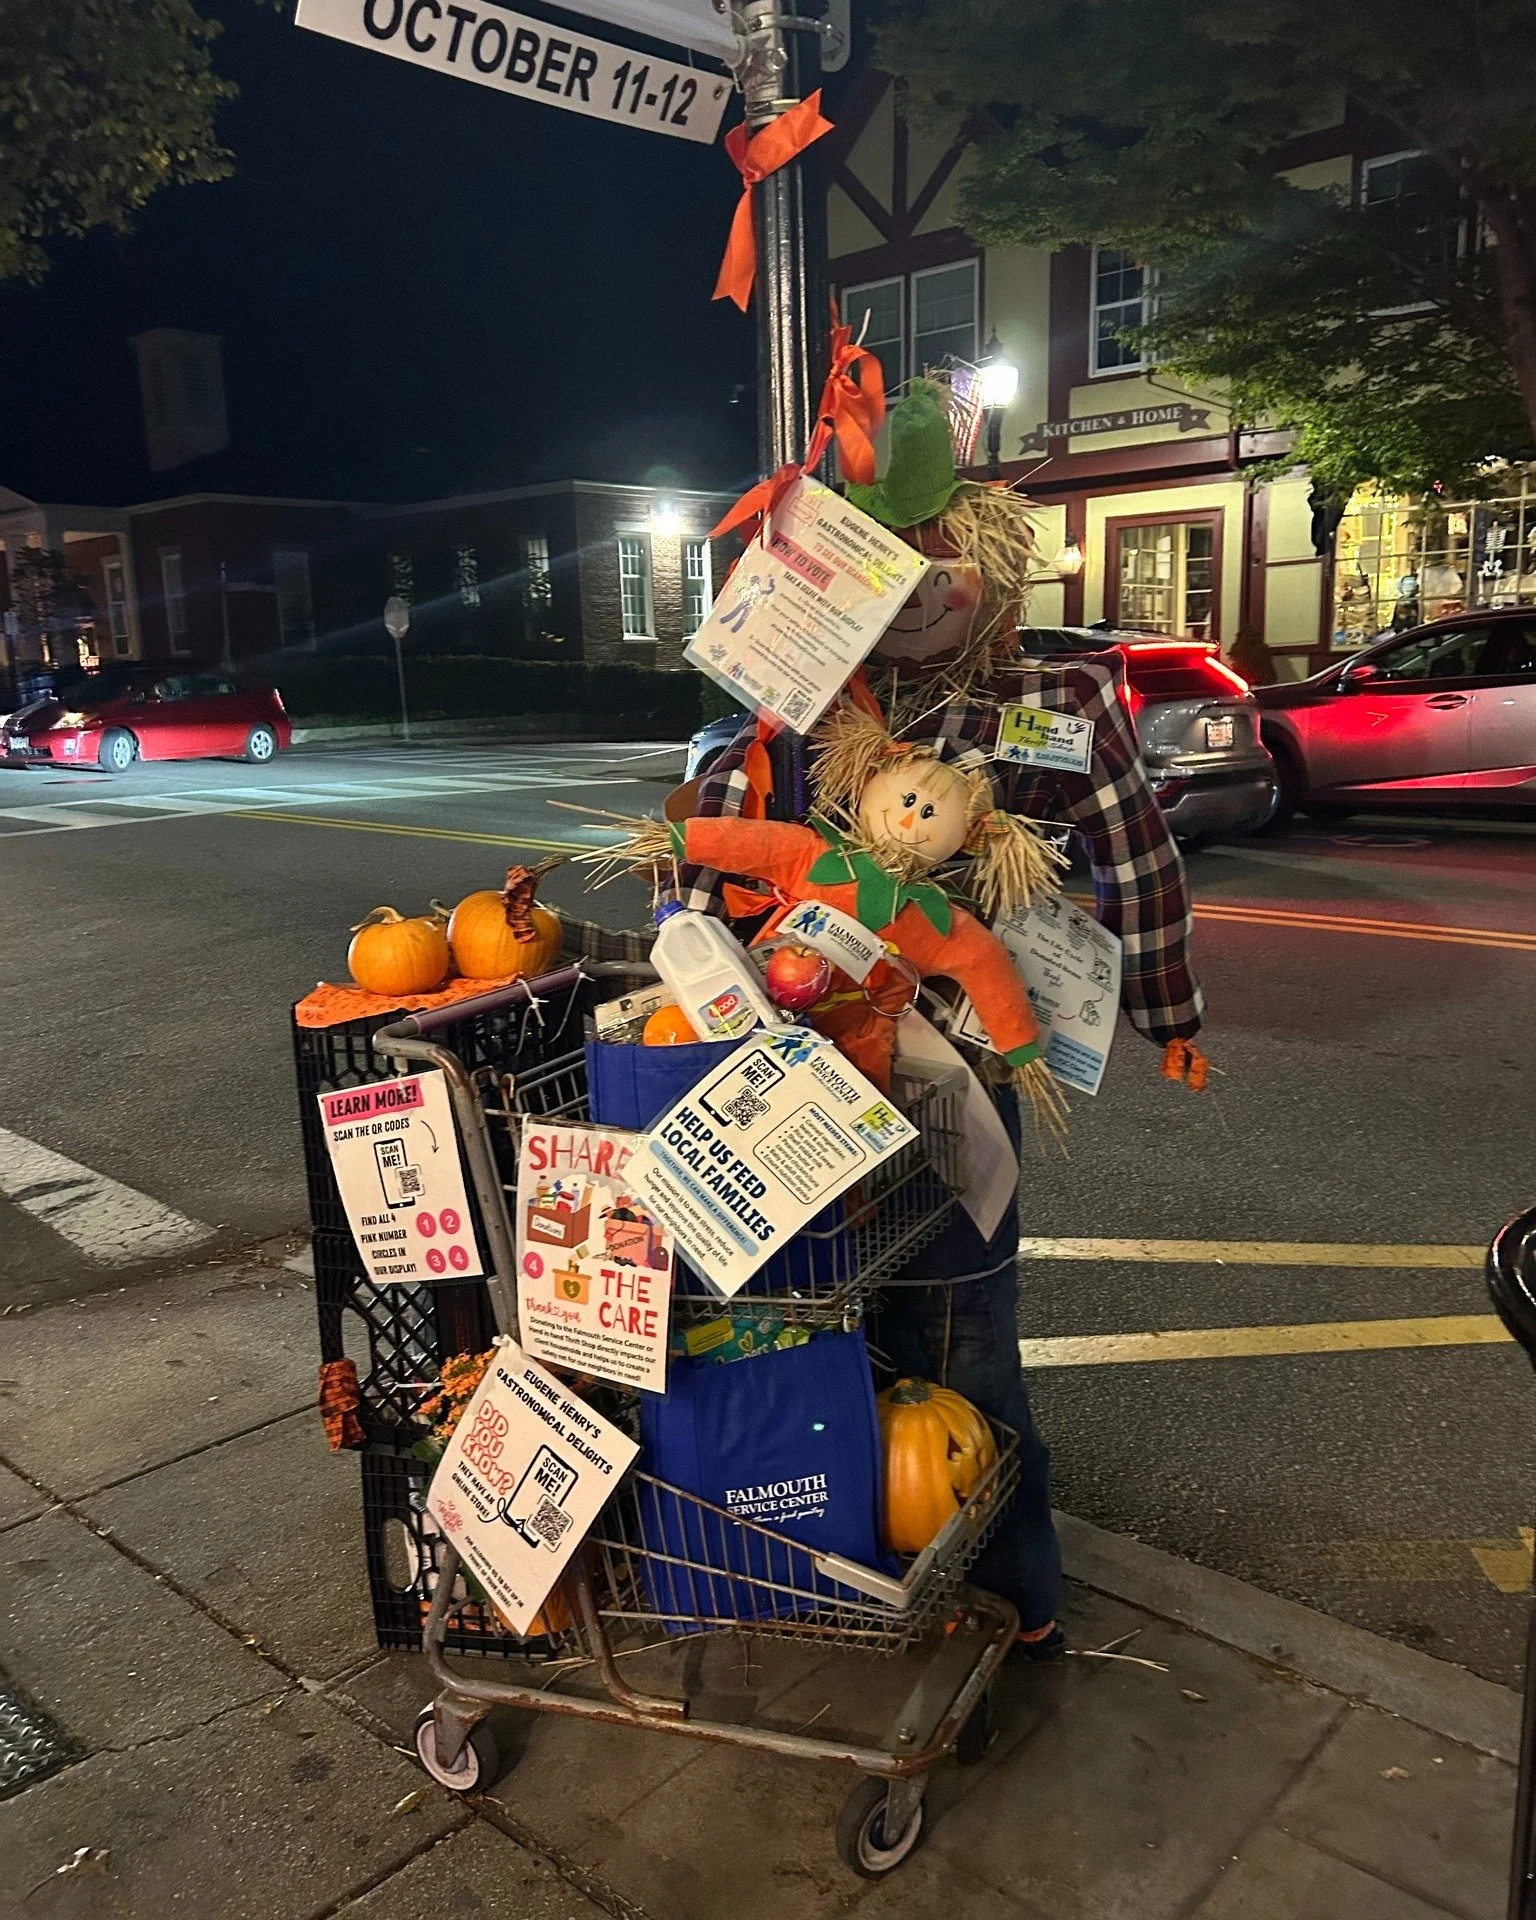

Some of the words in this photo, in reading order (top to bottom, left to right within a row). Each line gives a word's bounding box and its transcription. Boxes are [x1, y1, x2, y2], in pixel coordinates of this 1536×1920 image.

[363, 0, 600, 102] OCTOBER
[612, 60, 698, 127] 11-12
[1042, 415, 1114, 438] KITCHEN
[1131, 406, 1183, 425] HOME
[771, 536, 796, 557] HOW
[793, 553, 808, 567] TO
[806, 562, 831, 584] VOTE
[783, 571, 798, 584] TAKE
[816, 596, 832, 608] WITH
[1014, 711, 1058, 735] Hand
[1040, 731, 1074, 745] hand
[741, 1065, 766, 1089] ME!
[753, 1059, 775, 1079] SCAN
[810, 1062, 832, 1083] SERVICE
[831, 1083, 855, 1105] CENTER
[813, 1056, 861, 1101] FALMOUTH
[330, 1094, 370, 1118] LEARN
[375, 1085, 417, 1110] MORE!
[334, 1129, 353, 1142] SCAN
[355, 1125, 370, 1138] THE
[372, 1123, 383, 1135] QR
[385, 1117, 410, 1132] CODES
[809, 1108, 825, 1122] MOST
[823, 1122, 842, 1140] NEEDED
[380, 1145, 399, 1155] SCAN
[382, 1154, 401, 1168] ME!
[675, 1106, 713, 1142] HELP
[709, 1139, 734, 1165] US
[727, 1159, 767, 1199] FEED
[660, 1122, 706, 1172] LOCAL
[700, 1165, 775, 1241] FAMILIES
[683, 1176, 691, 1184] WE
[690, 1183, 701, 1195] CAN
[699, 1194, 714, 1209] MAKE
[361, 1216, 377, 1226] FIND
[379, 1214, 390, 1224] ALL
[391, 1213, 396, 1222] 4
[422, 1219, 430, 1231] 1
[445, 1215, 455, 1228] 2
[644, 1173, 661, 1193] hunger
[659, 1192, 671, 1204] and
[668, 1201, 689, 1224] improve
[687, 1222, 697, 1233] the
[695, 1232, 714, 1252] quality
[712, 1250, 721, 1258] of
[718, 1255, 728, 1267] life
[648, 1195, 657, 1204] for
[655, 1204, 665, 1214] our
[663, 1213, 688, 1239] neighbors
[686, 1237, 693, 1245] in
[653, 1167, 663, 1178] Our
[661, 1178, 680, 1198] mission
[683, 1201, 690, 1209] to
[689, 1208, 701, 1221] ease
[699, 1220, 715, 1238] stress,
[714, 1236, 734, 1256] reduce
[361, 1234, 377, 1243] PINK
[378, 1229, 407, 1242] NUMBER
[372, 1248, 397, 1259] CIRCLES
[398, 1247, 406, 1256] IN
[374, 1266, 388, 1275] OUR
[388, 1263, 417, 1274] DISPLAY!
[431, 1255, 441, 1267] 3
[454, 1252, 464, 1264] 4
[529, 1260, 538, 1272] 4
[600, 1269, 652, 1304] THE
[530, 1316, 556, 1330] Donating
[573, 1328, 601, 1340] Falmouth
[602, 1335, 623, 1345] Service
[624, 1340, 645, 1350] Center
[599, 1301, 658, 1338] CARE
[477, 1399, 509, 1438] DID
[523, 1369, 561, 1405] EUGENE
[559, 1401, 601, 1439] HENRY'S
[470, 1416, 504, 1459] YOU
[497, 1368, 566, 1437] GASTRONOMICAL
[566, 1432, 613, 1475] DELIGHTS
[458, 1461, 473, 1478] THEY
[471, 1477, 487, 1495] HAVE
[484, 1494, 495, 1505] AN
[460, 1434, 515, 1502] KNOW?
[534, 1467, 561, 1497] ME!
[543, 1457, 568, 1483] SCAN
[452, 1473, 472, 1497] ONLINE
[470, 1495, 490, 1518] STORE!
[725, 1473, 827, 1504] FALMOUTH
[726, 1498, 778, 1517] SERVICE
[778, 1491, 829, 1508] CENTER
